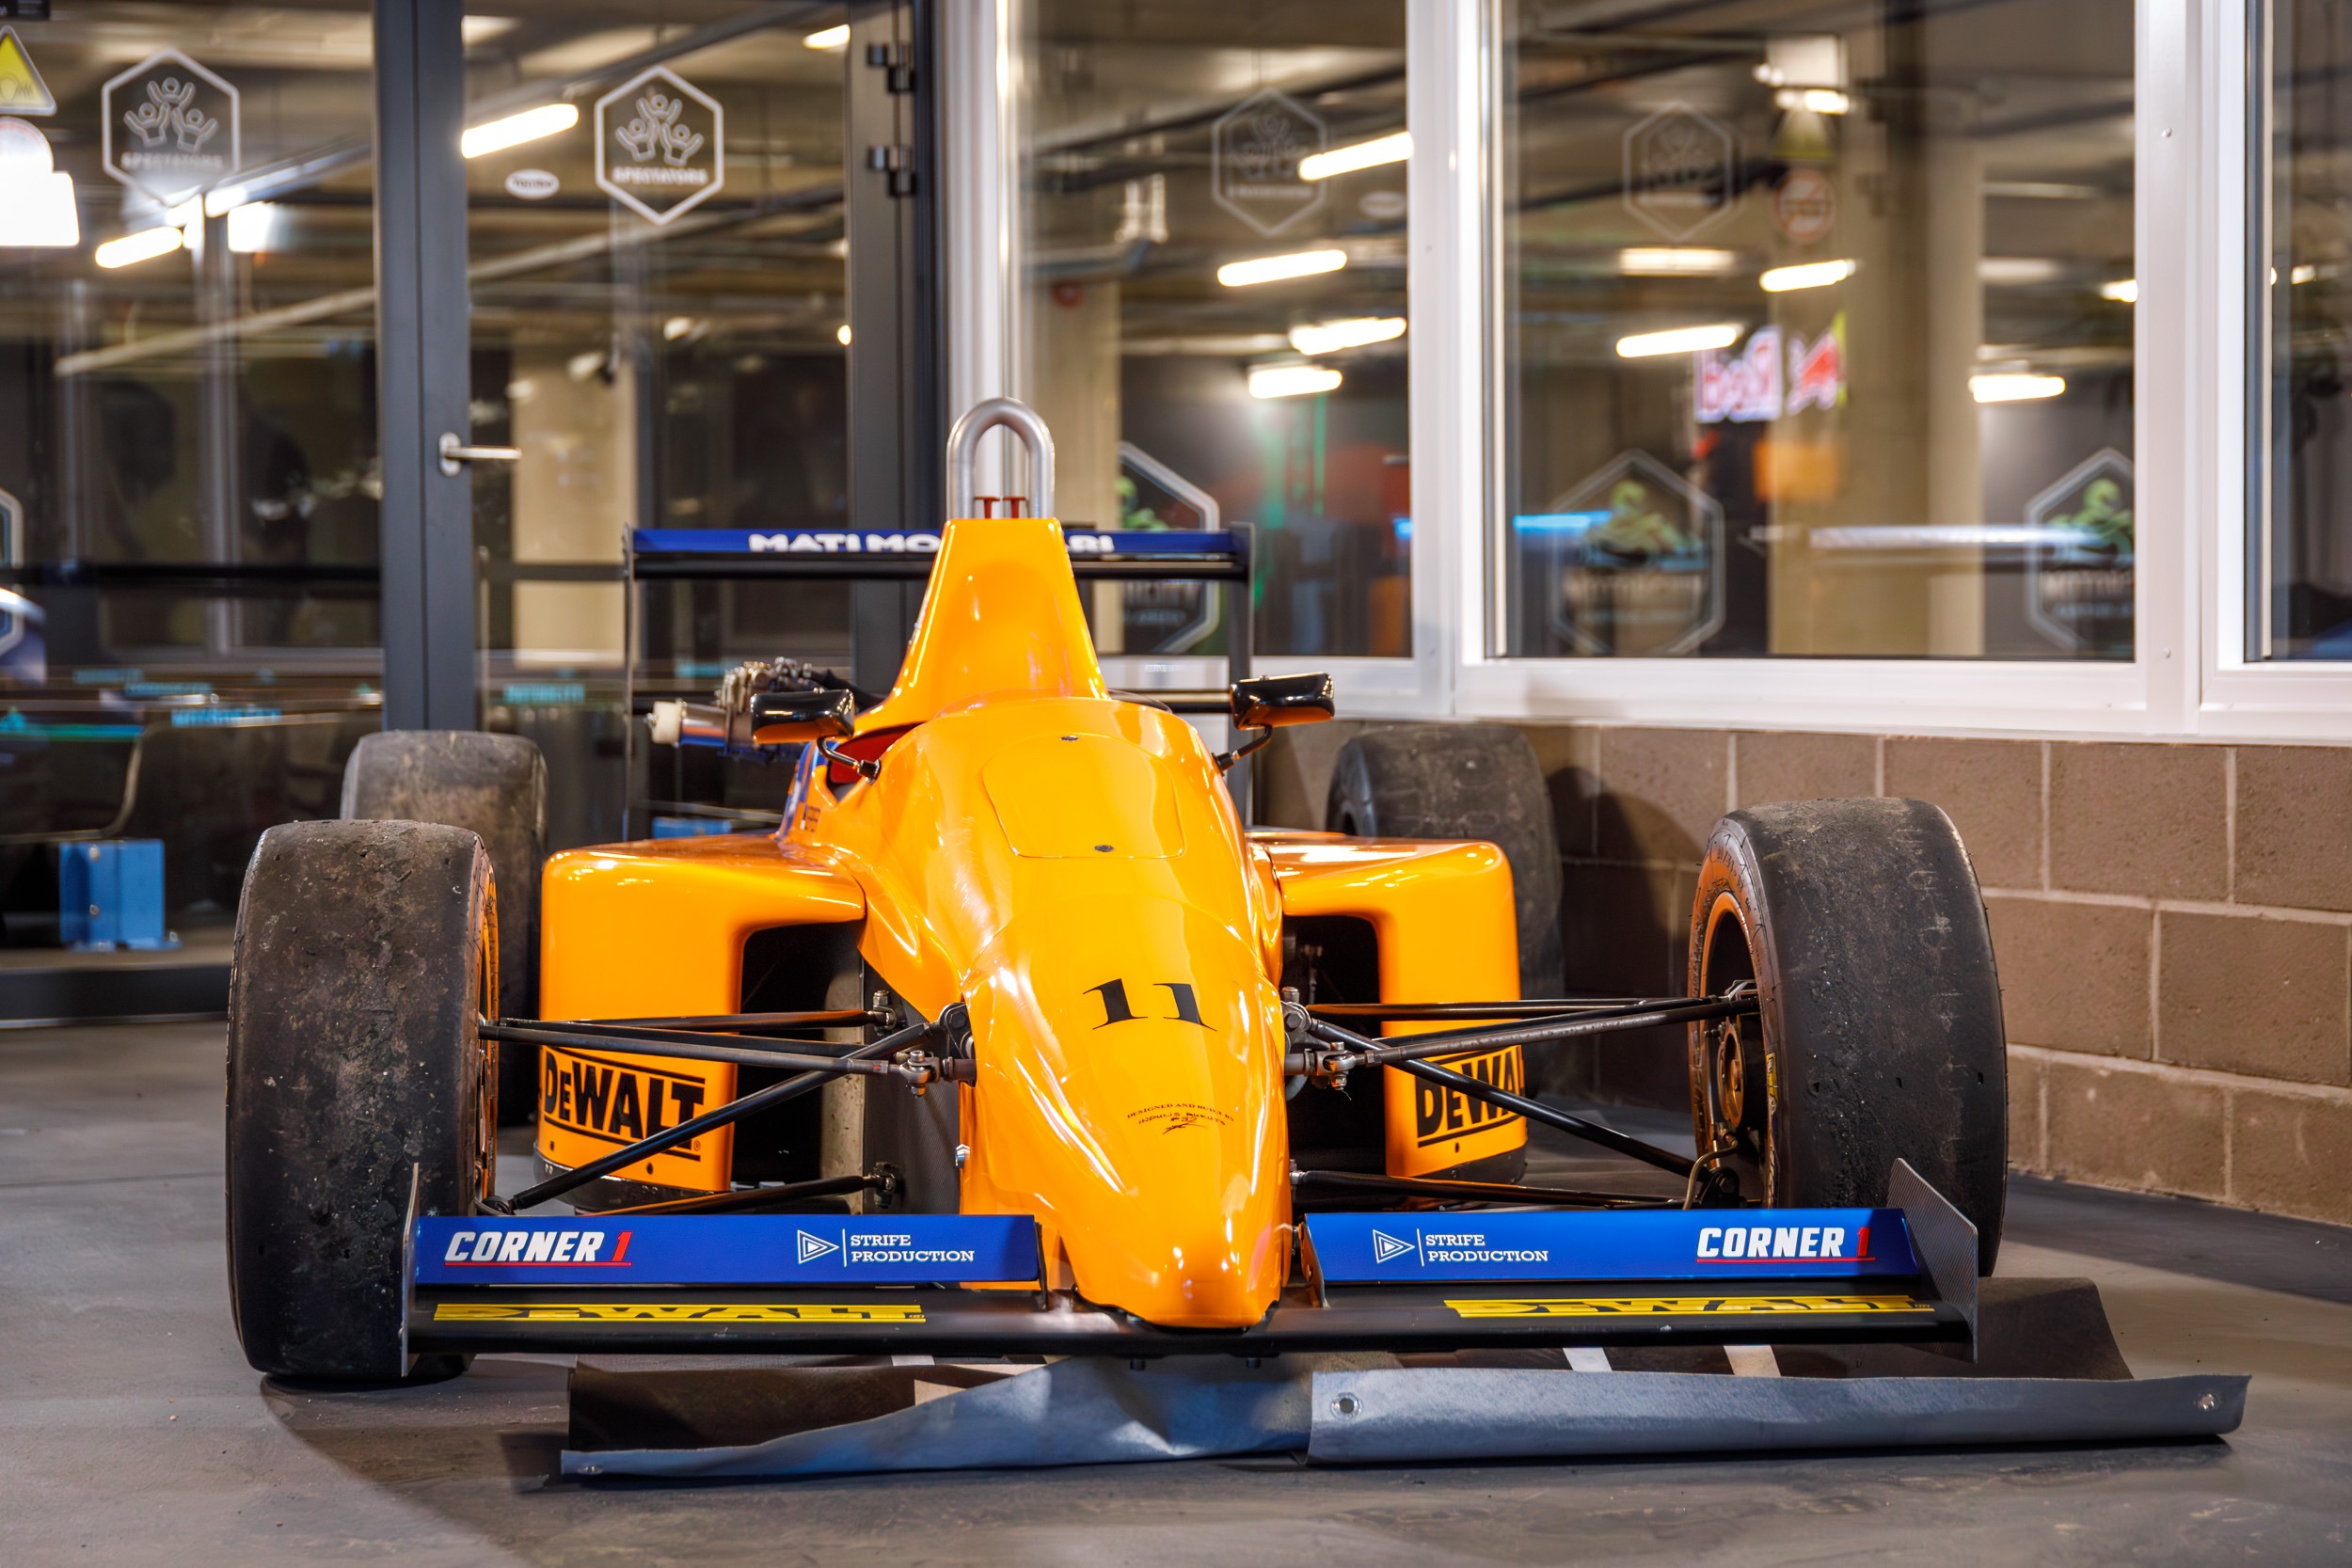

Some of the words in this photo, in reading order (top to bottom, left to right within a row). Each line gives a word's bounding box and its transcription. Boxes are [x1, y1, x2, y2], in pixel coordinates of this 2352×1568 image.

[748, 533, 862, 552] MATI
[1083, 977, 1217, 1031] 11
[1127, 1103, 1174, 1119] DESIGNED
[444, 1231, 605, 1262] CORNER
[612, 1231, 633, 1262] 1
[850, 1234, 912, 1246] STRIFE
[1425, 1234, 1486, 1246] STRIFE
[1697, 1227, 1845, 1258] CORNER
[1856, 1227, 1871, 1258] 1
[851, 1250, 975, 1262] PRODUCTION
[1428, 1250, 1549, 1262] PRODUCTION
